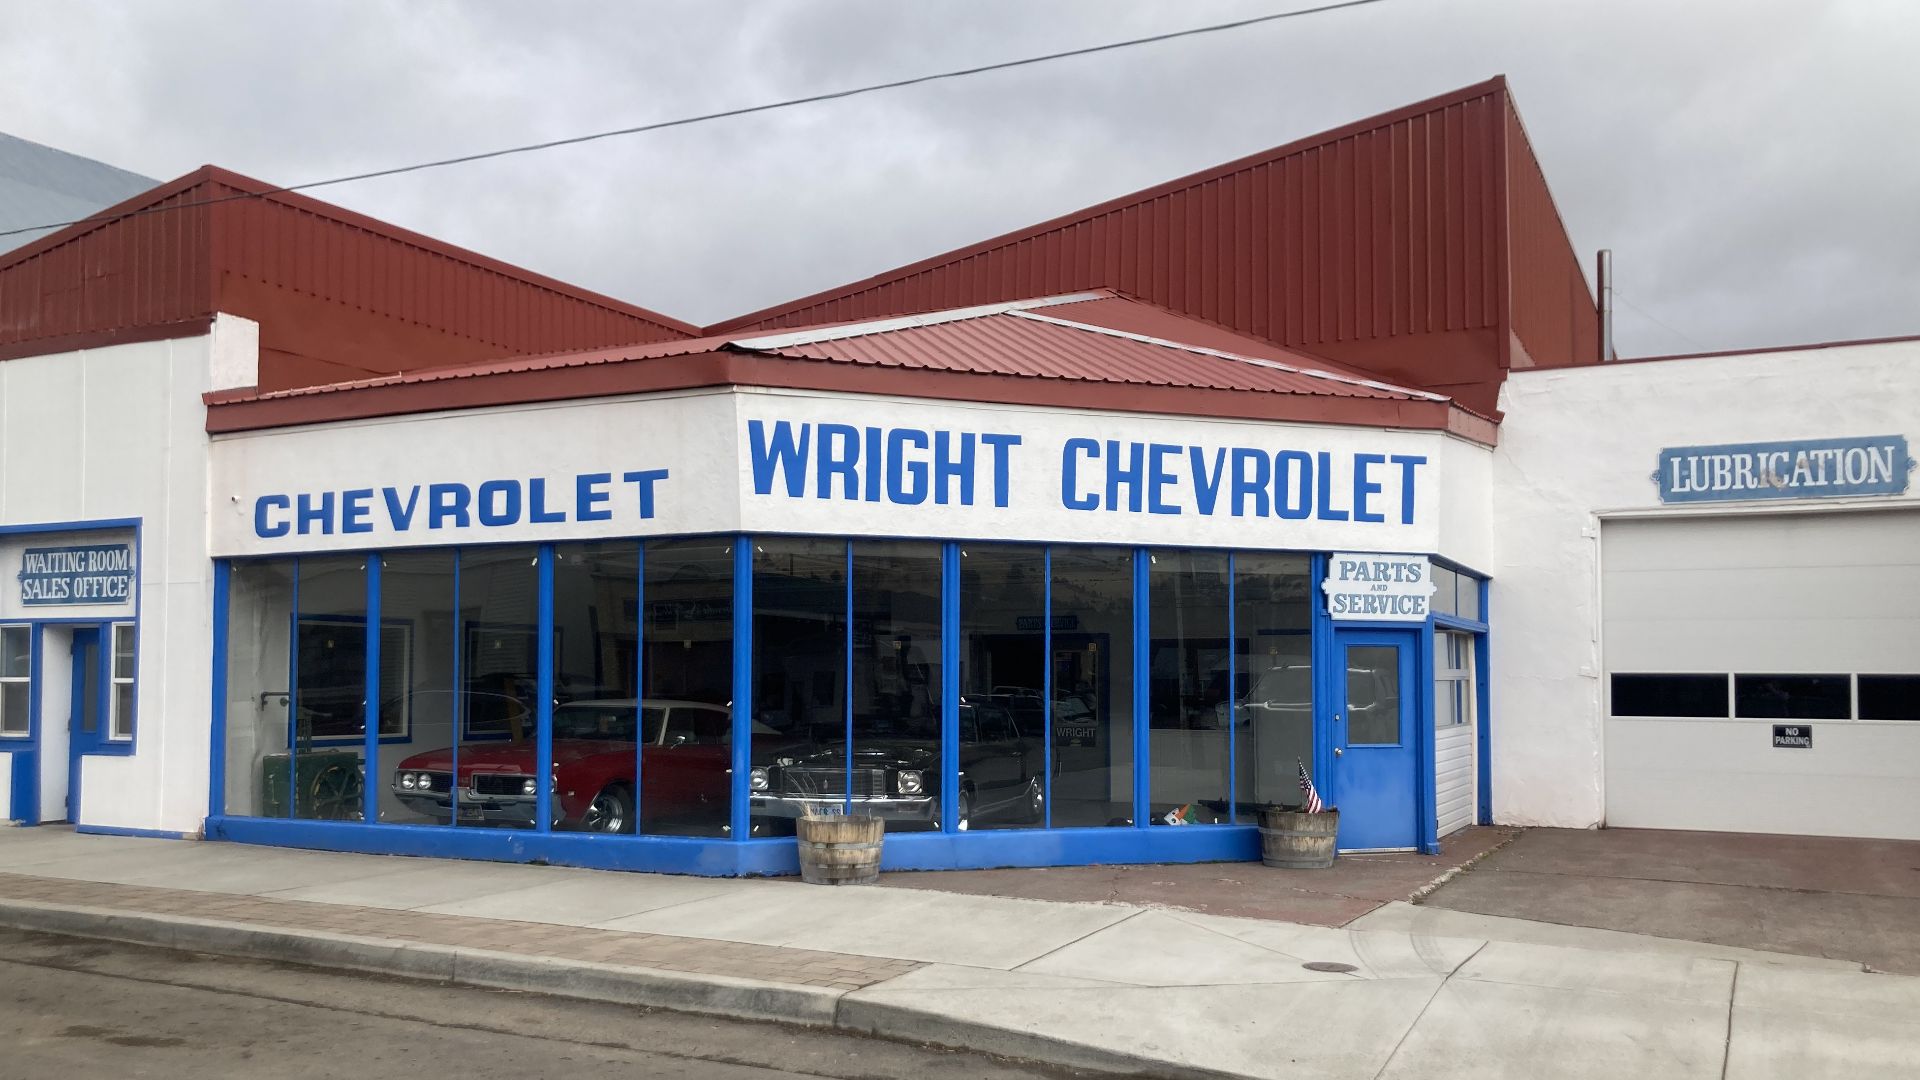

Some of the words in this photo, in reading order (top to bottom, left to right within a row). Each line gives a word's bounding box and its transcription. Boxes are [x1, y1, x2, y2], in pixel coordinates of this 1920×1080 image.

[748, 420, 1022, 508] WRIGHT
[1062, 437, 1427, 525] CHEVROLET
[1670, 446, 1895, 492] LUBRICATION
[254, 469, 669, 538] CHEVROLET
[25, 552, 85, 573] WAITING
[88, 549, 128, 572] ROOM
[1339, 560, 1422, 583] PARTS
[22, 578, 70, 599] SALES
[73, 576, 127, 598] OFFICE
[1332, 593, 1426, 615] SERVICE
[1056, 727, 1096, 737] WRIGHT
[1775, 736, 1810, 745] PARKING
[1785, 727, 1799, 736] NO
